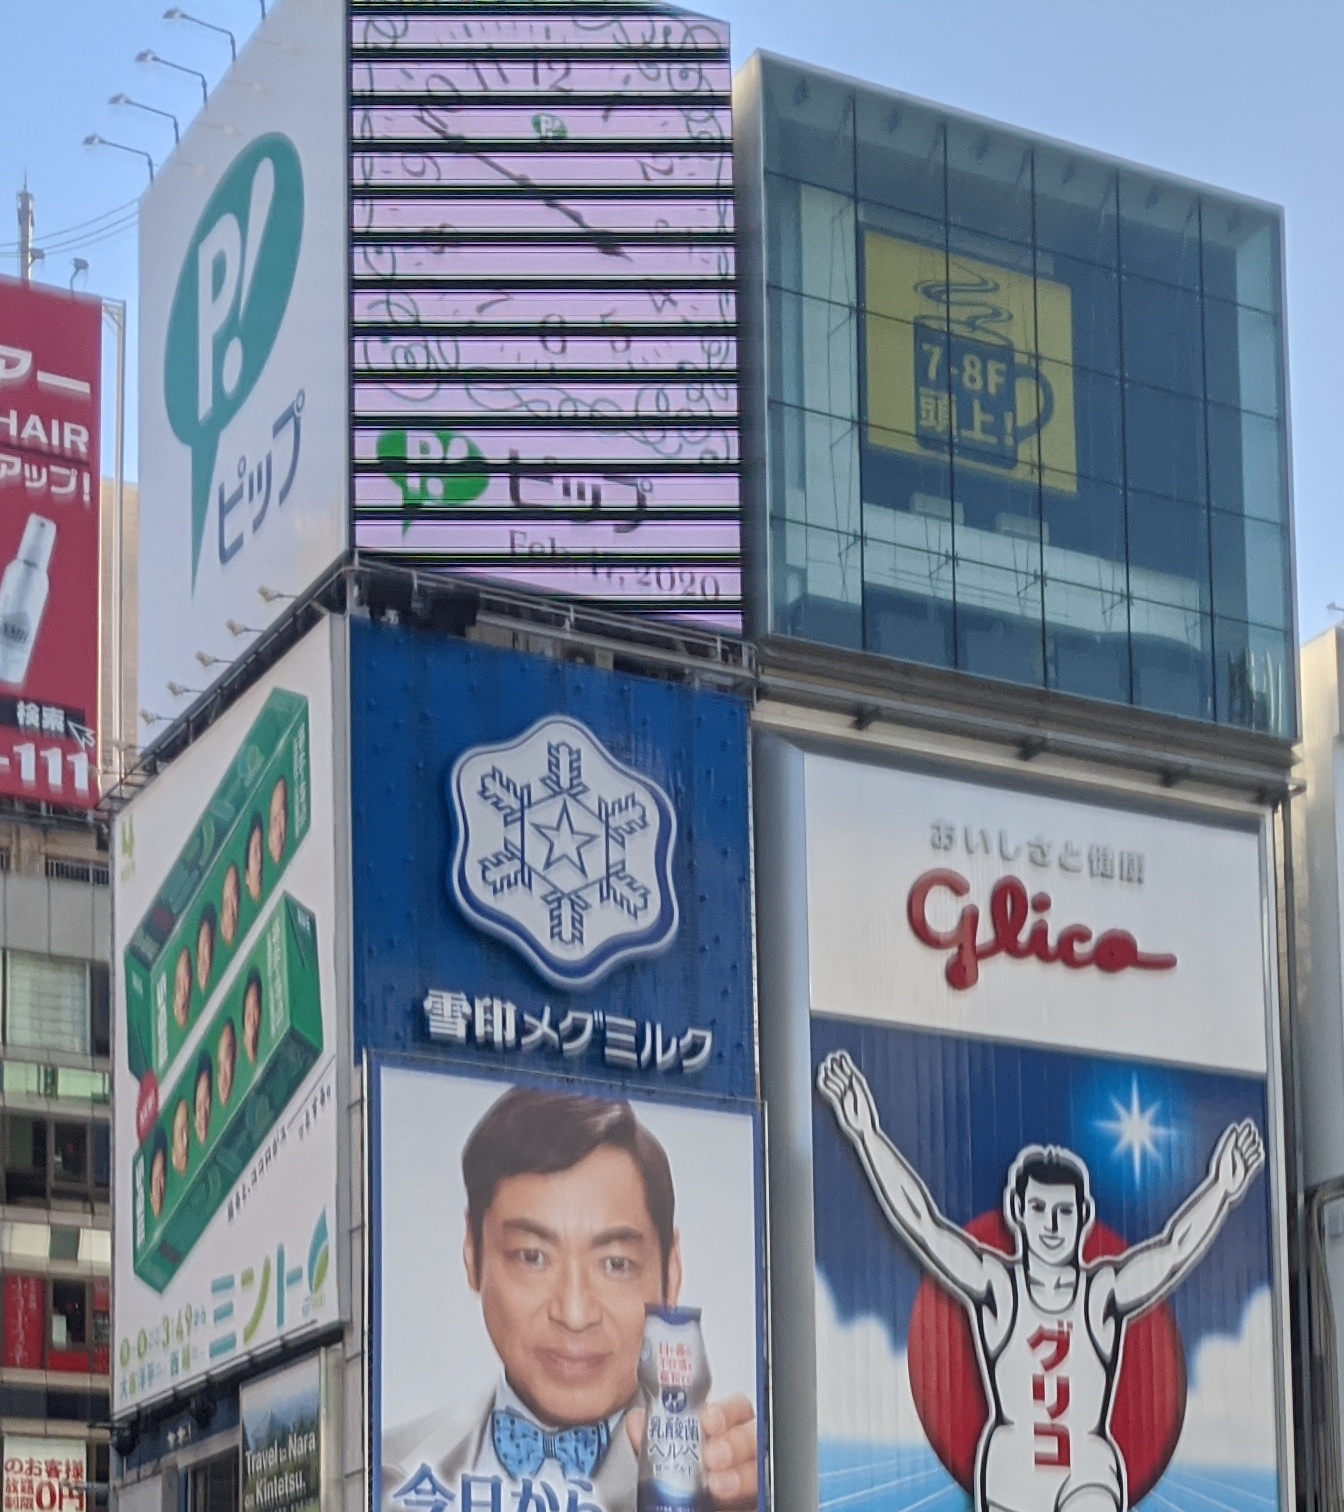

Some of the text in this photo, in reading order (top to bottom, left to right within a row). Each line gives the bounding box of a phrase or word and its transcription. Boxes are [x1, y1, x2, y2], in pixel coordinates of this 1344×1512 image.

[217, 388, 306, 566] ピップ
[508, 448, 654, 533] ピップ
[15, 699, 66, 732] 検索
[930, 817, 1145, 884] おいしさと健康
[423, 988, 713, 1072] 雪印メグミルク
[208, 1240, 304, 1361] ミント
[649, 1415, 700, 1441] 乳酸菌
[1026, 1319, 1074, 1473] グリコ
[245, 1437, 278, 1477] Travel
[288, 1431, 316, 1463] Nara
[256, 1469, 306, 1507] Kintetsu.
